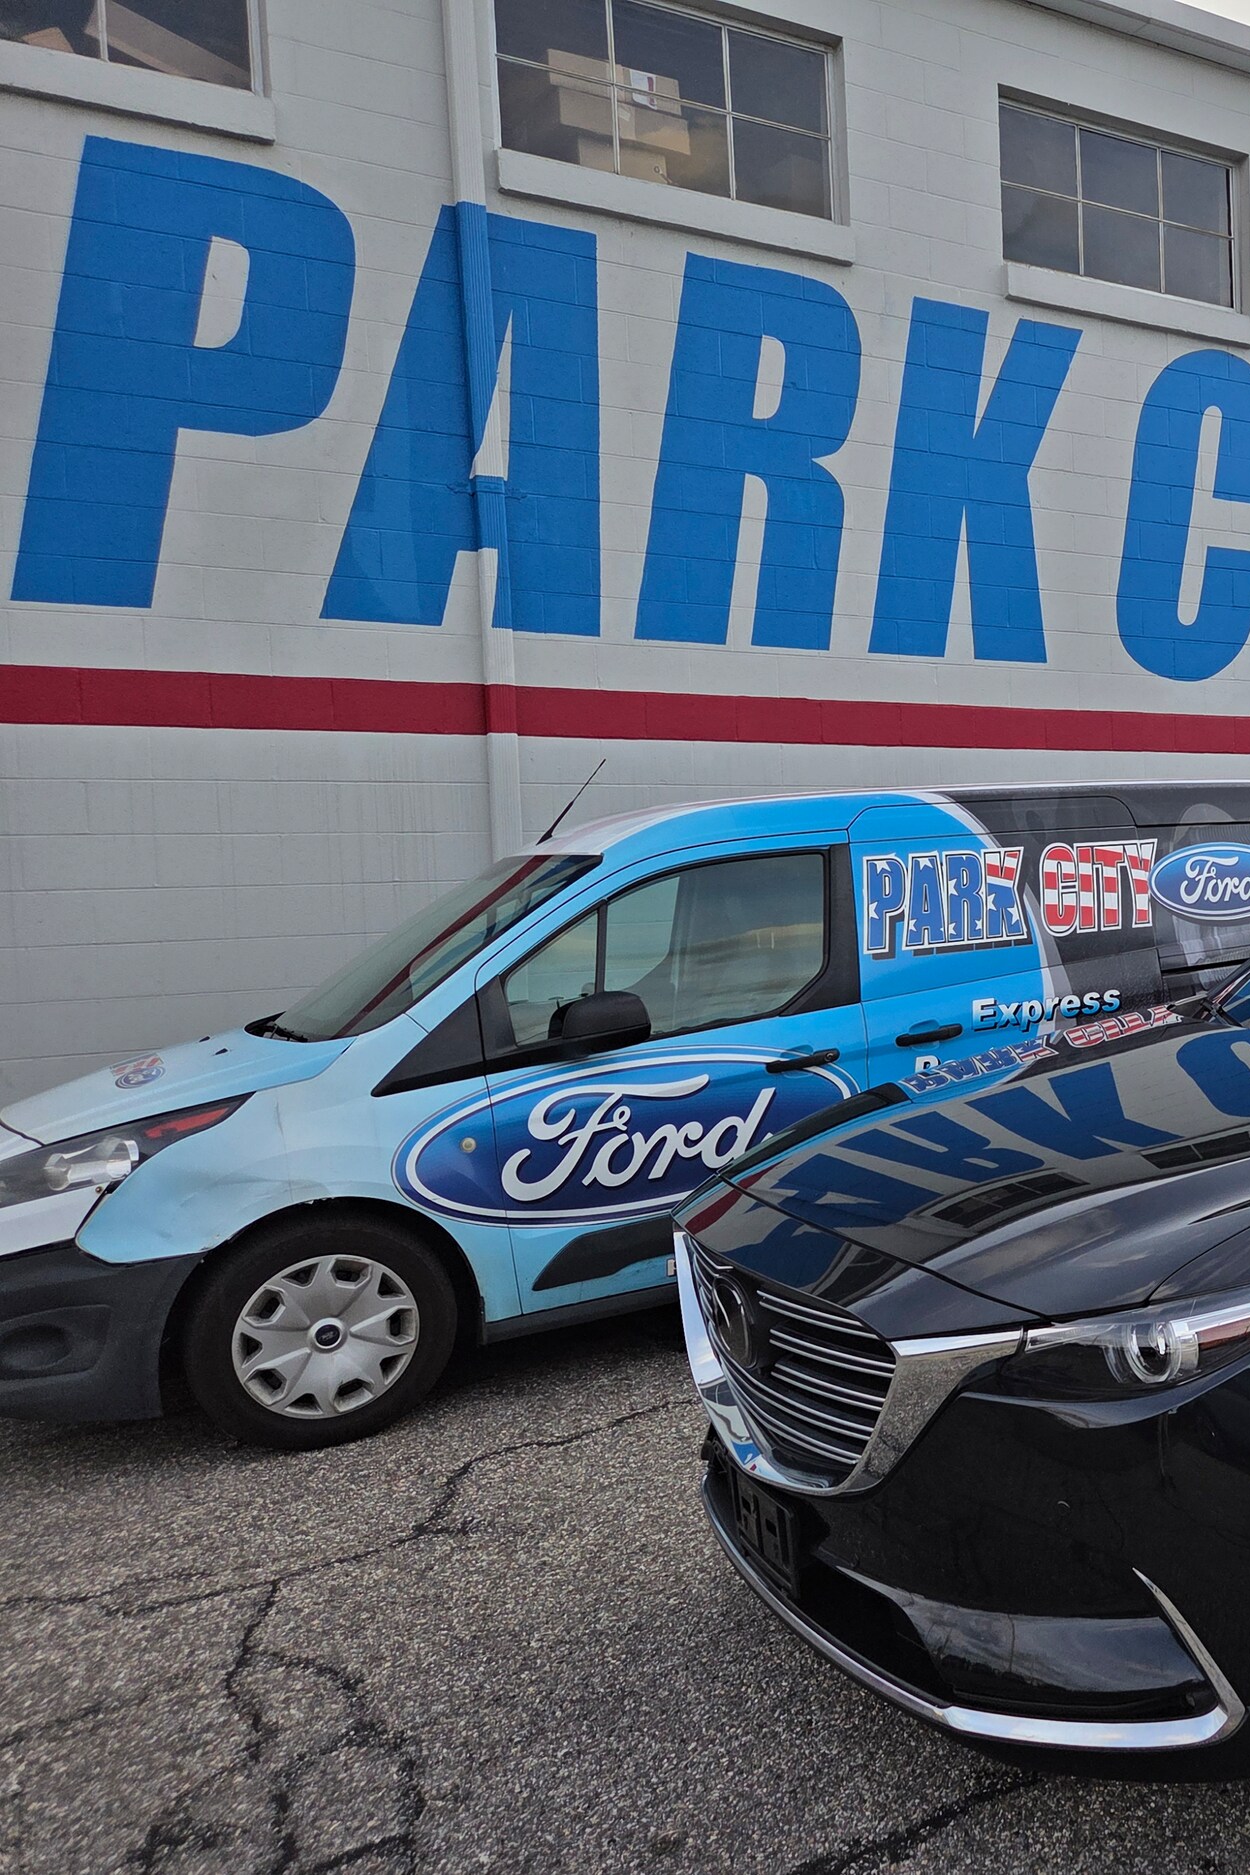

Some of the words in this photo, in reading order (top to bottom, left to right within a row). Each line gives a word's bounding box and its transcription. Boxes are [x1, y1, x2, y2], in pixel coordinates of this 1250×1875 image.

[11, 134, 1083, 663] PARK
[863, 845, 1028, 954] PARK
[1039, 838, 1158, 938] CITY
[970, 988, 1122, 1033] Express
[501, 1073, 777, 1202] Ford
